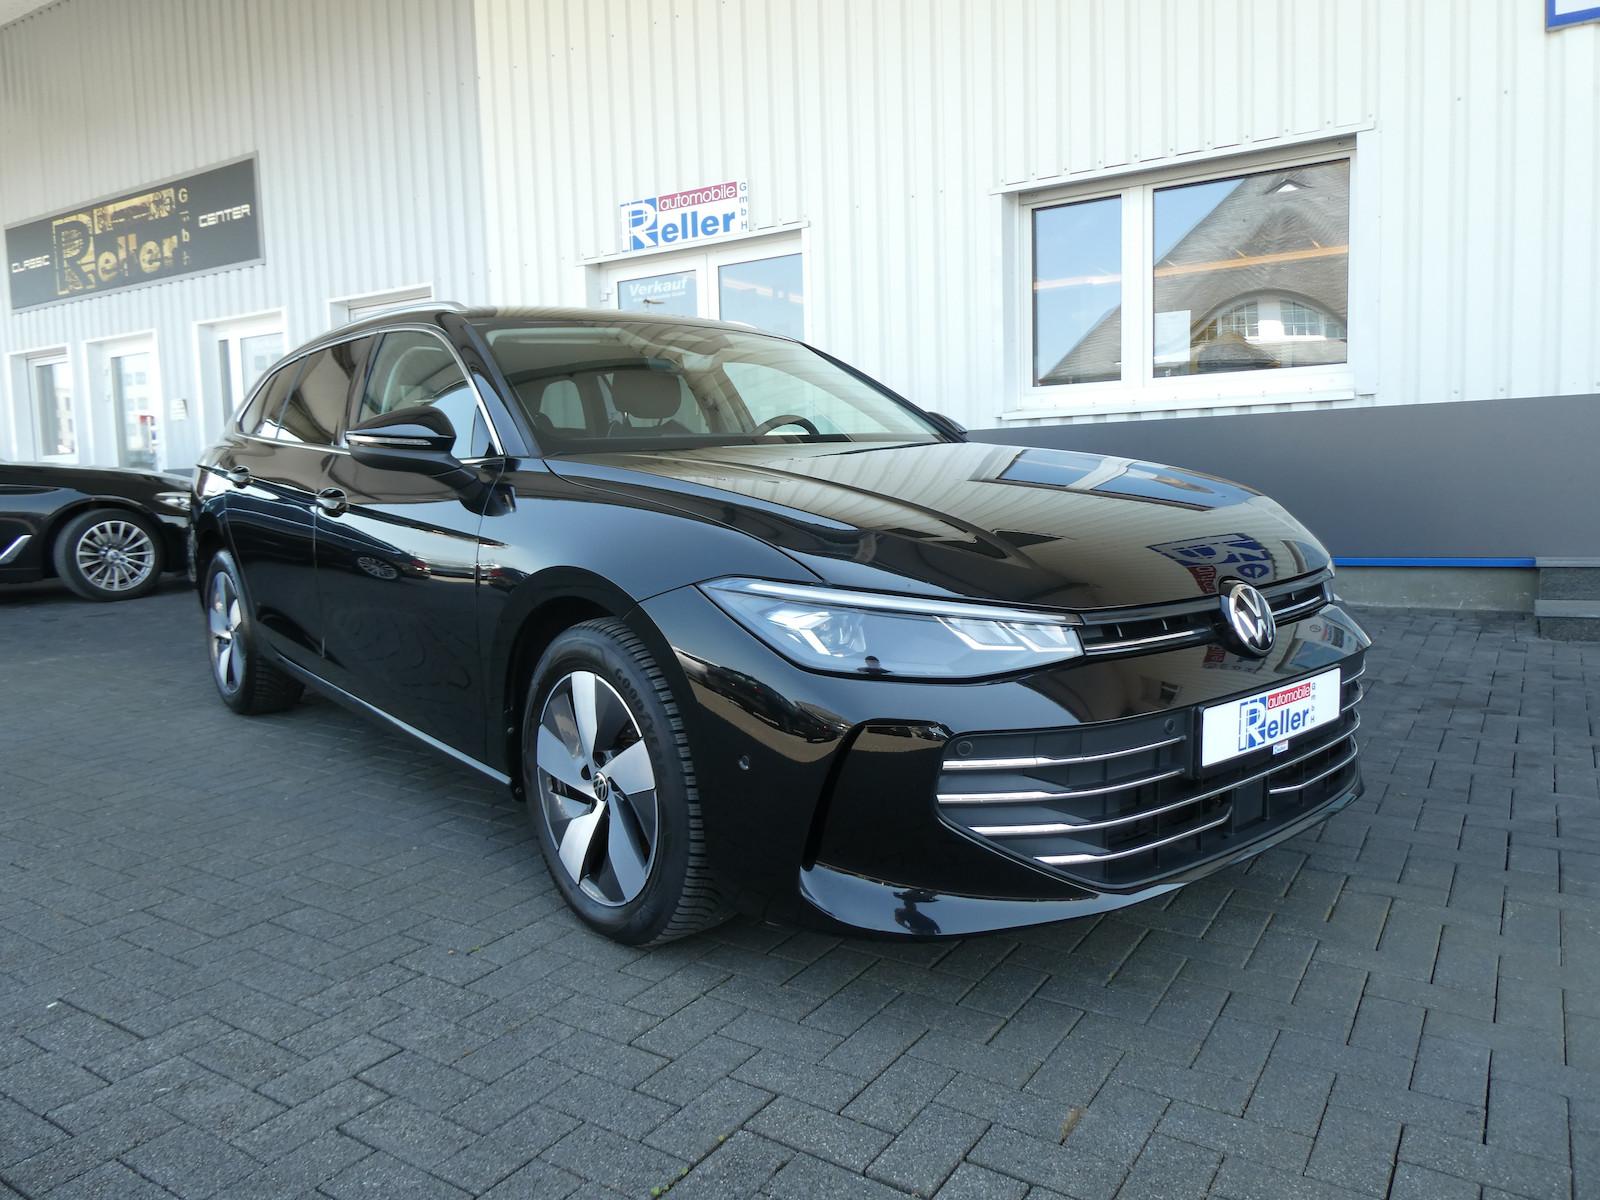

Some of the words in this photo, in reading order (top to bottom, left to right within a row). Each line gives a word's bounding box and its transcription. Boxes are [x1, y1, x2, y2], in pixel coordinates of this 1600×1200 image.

[659, 184, 736, 211] automobile
[739, 182, 748, 230] GmbH
[198, 203, 251, 228] CENTER
[620, 201, 736, 252] Reller
[629, 276, 688, 296] Verkauf
[1268, 686, 1310, 708] automobile
[1238, 697, 1310, 752] Reller
